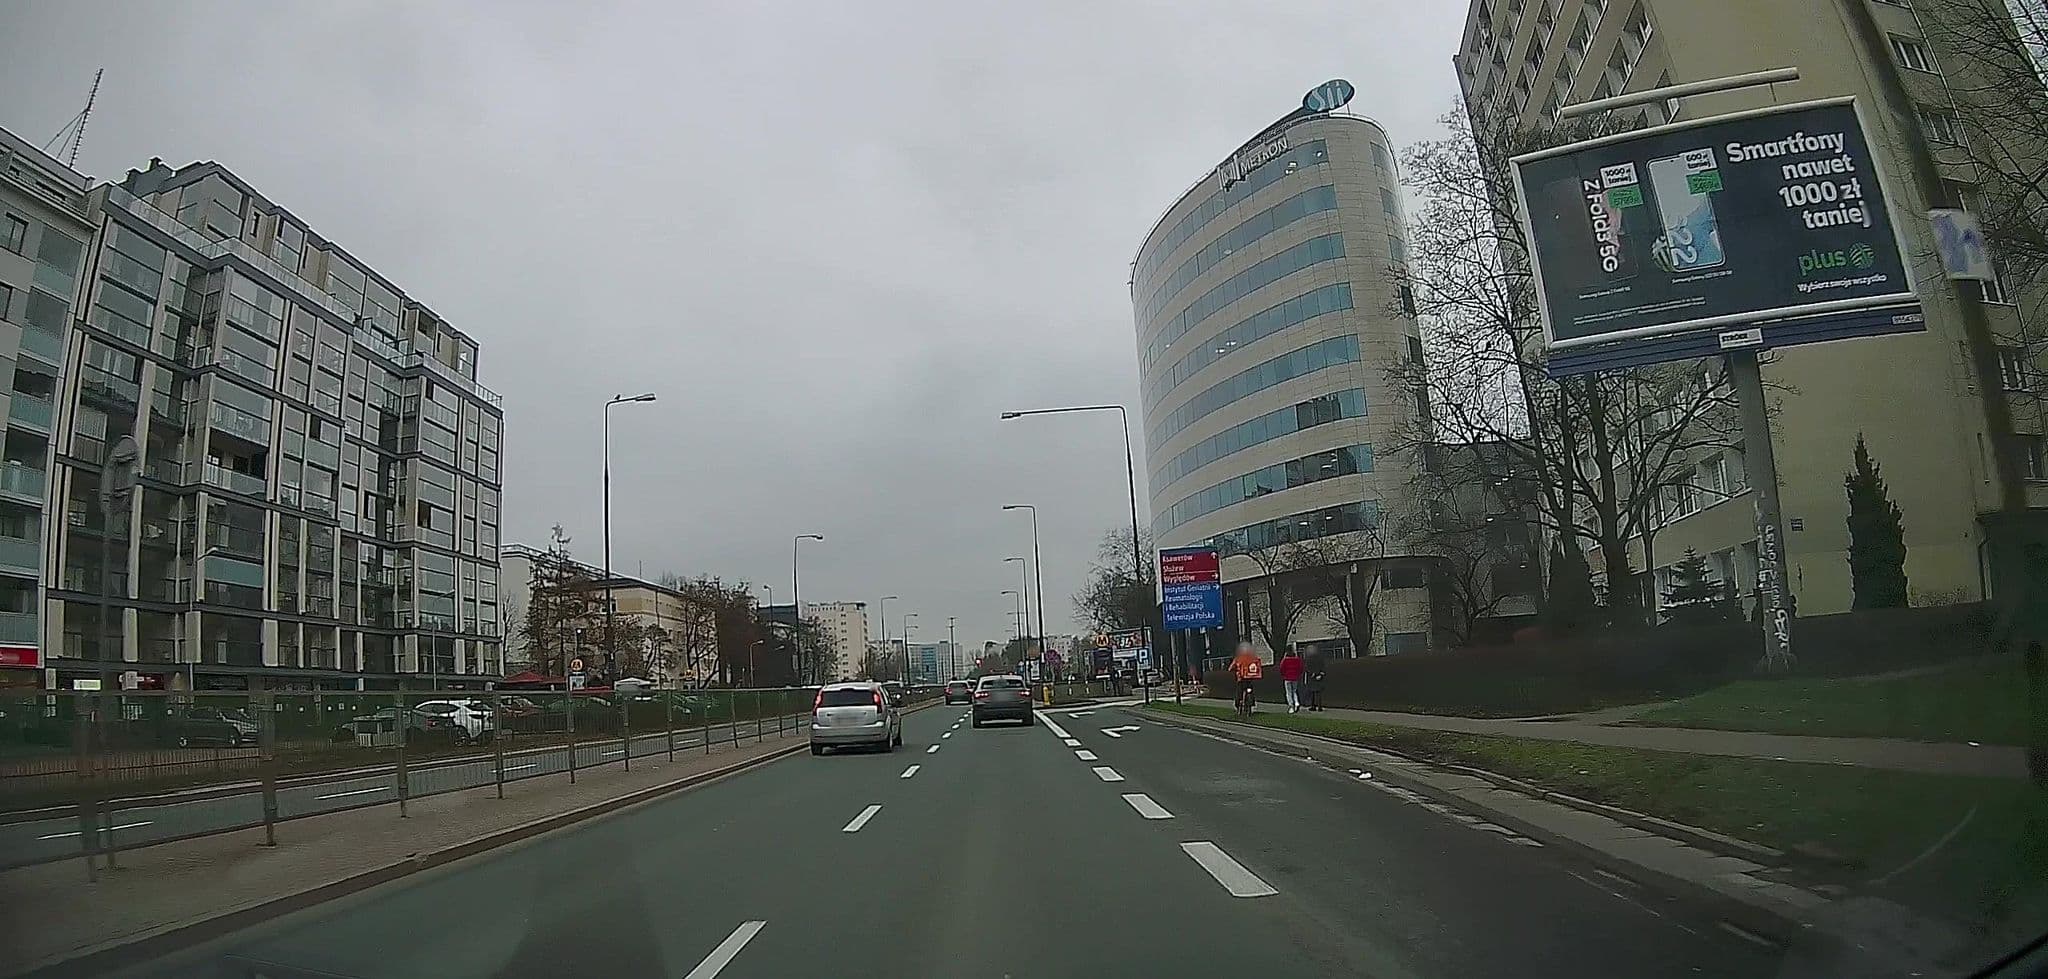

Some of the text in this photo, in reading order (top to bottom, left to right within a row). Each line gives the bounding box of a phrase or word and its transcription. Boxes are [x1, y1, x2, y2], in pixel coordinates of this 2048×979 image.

[1726, 131, 1845, 162] Smartfony
[1605, 167, 1625, 177] 1000
[1782, 153, 1856, 180] nawet
[1778, 177, 1863, 208] 1000 zł
[1583, 178, 1619, 272] Z Fold3 5G
[1802, 200, 1873, 229] taniej
[1798, 249, 1848, 276] plus
[1195, 611, 1215, 620] Polska
